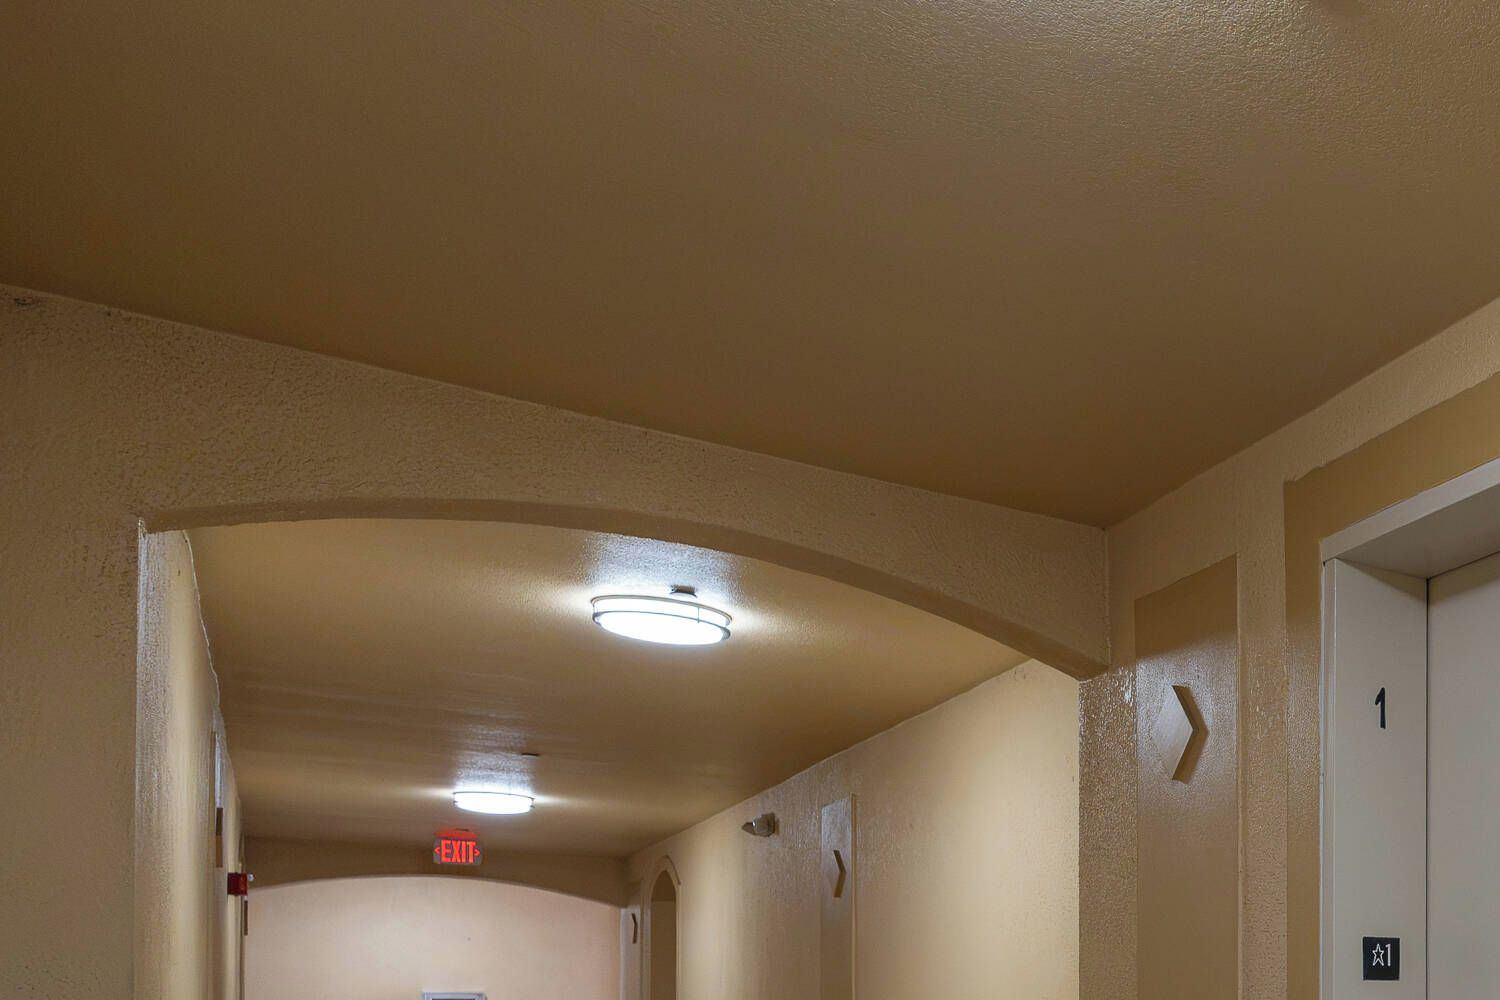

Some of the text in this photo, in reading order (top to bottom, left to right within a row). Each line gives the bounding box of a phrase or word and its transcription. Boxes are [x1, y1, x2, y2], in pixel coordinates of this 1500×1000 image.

[1375, 687, 1386, 729] 1
[441, 840, 476, 864] EXIT
[1385, 943, 1391, 966] 1
